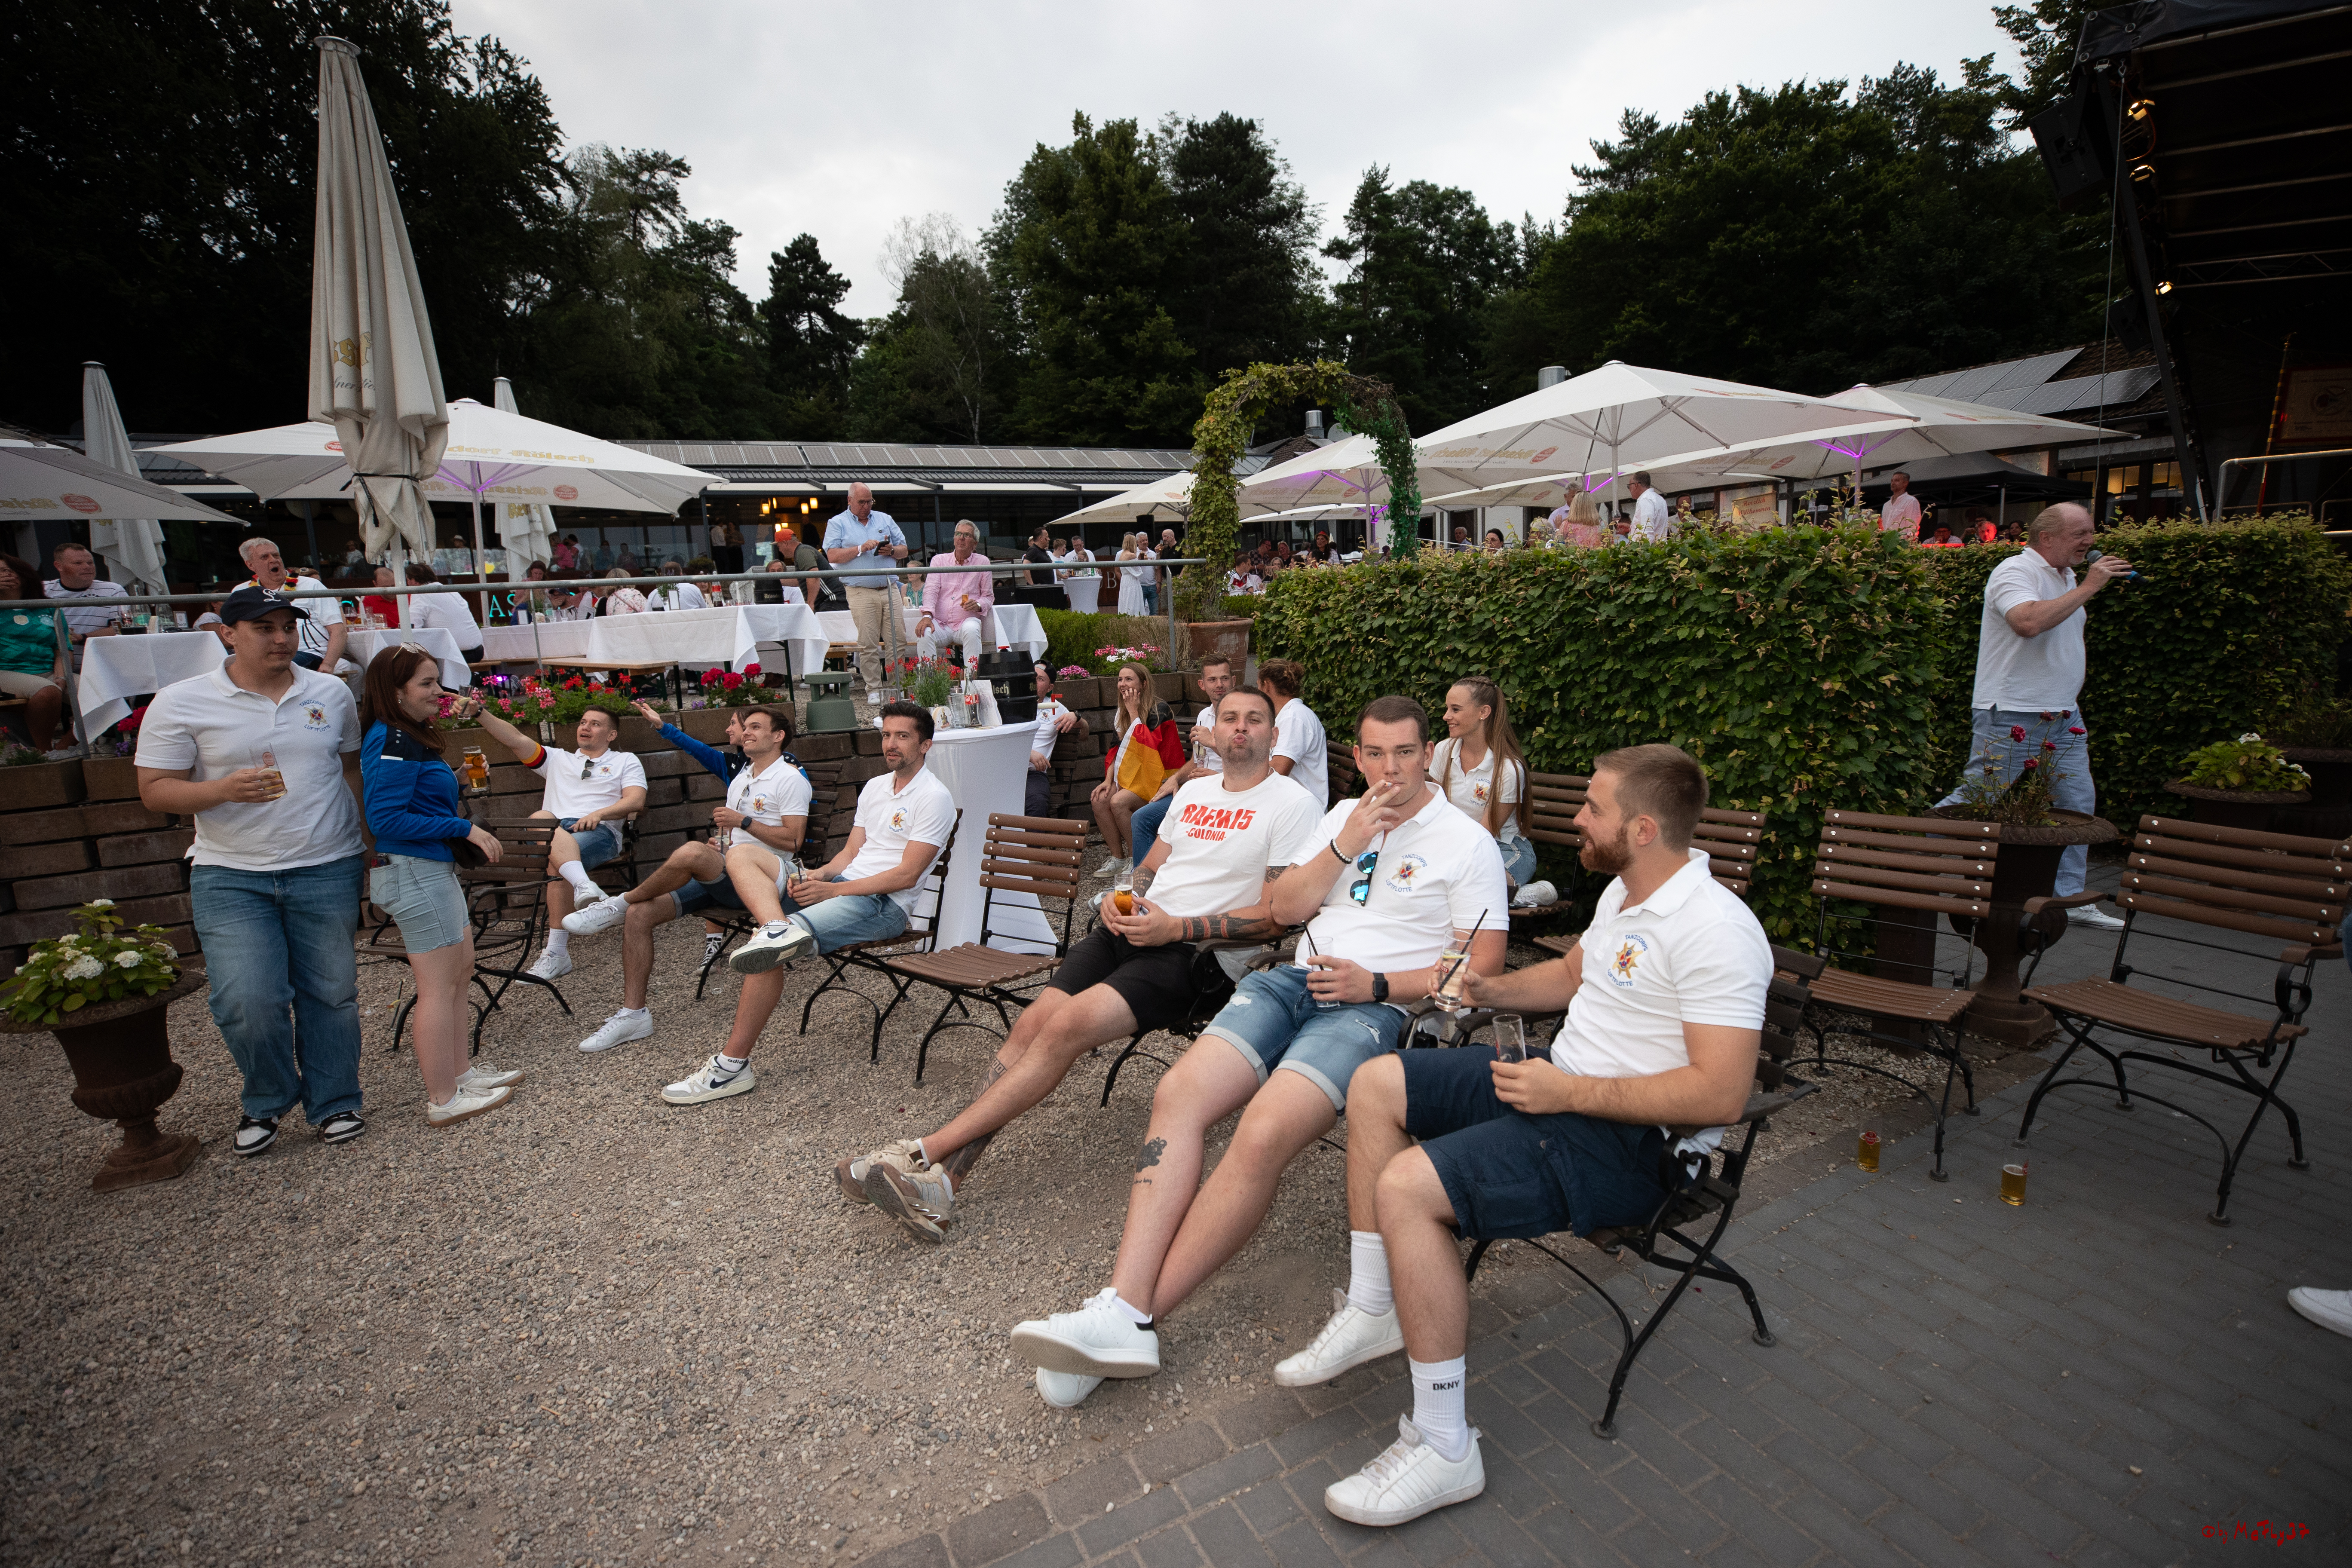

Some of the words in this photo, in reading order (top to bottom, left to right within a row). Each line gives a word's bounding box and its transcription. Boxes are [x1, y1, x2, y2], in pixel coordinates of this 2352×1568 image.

[299, 700, 326, 708] TANZCORPS
[1401, 854, 1427, 867] TANZCORPS
[1385, 879, 1413, 893] LUFTFLOTTE
[1625, 934, 1648, 952] TANZCORPS
[1608, 968, 1633, 987] LUFTFLOTTE
[1433, 1380, 1460, 1390] DKNY
